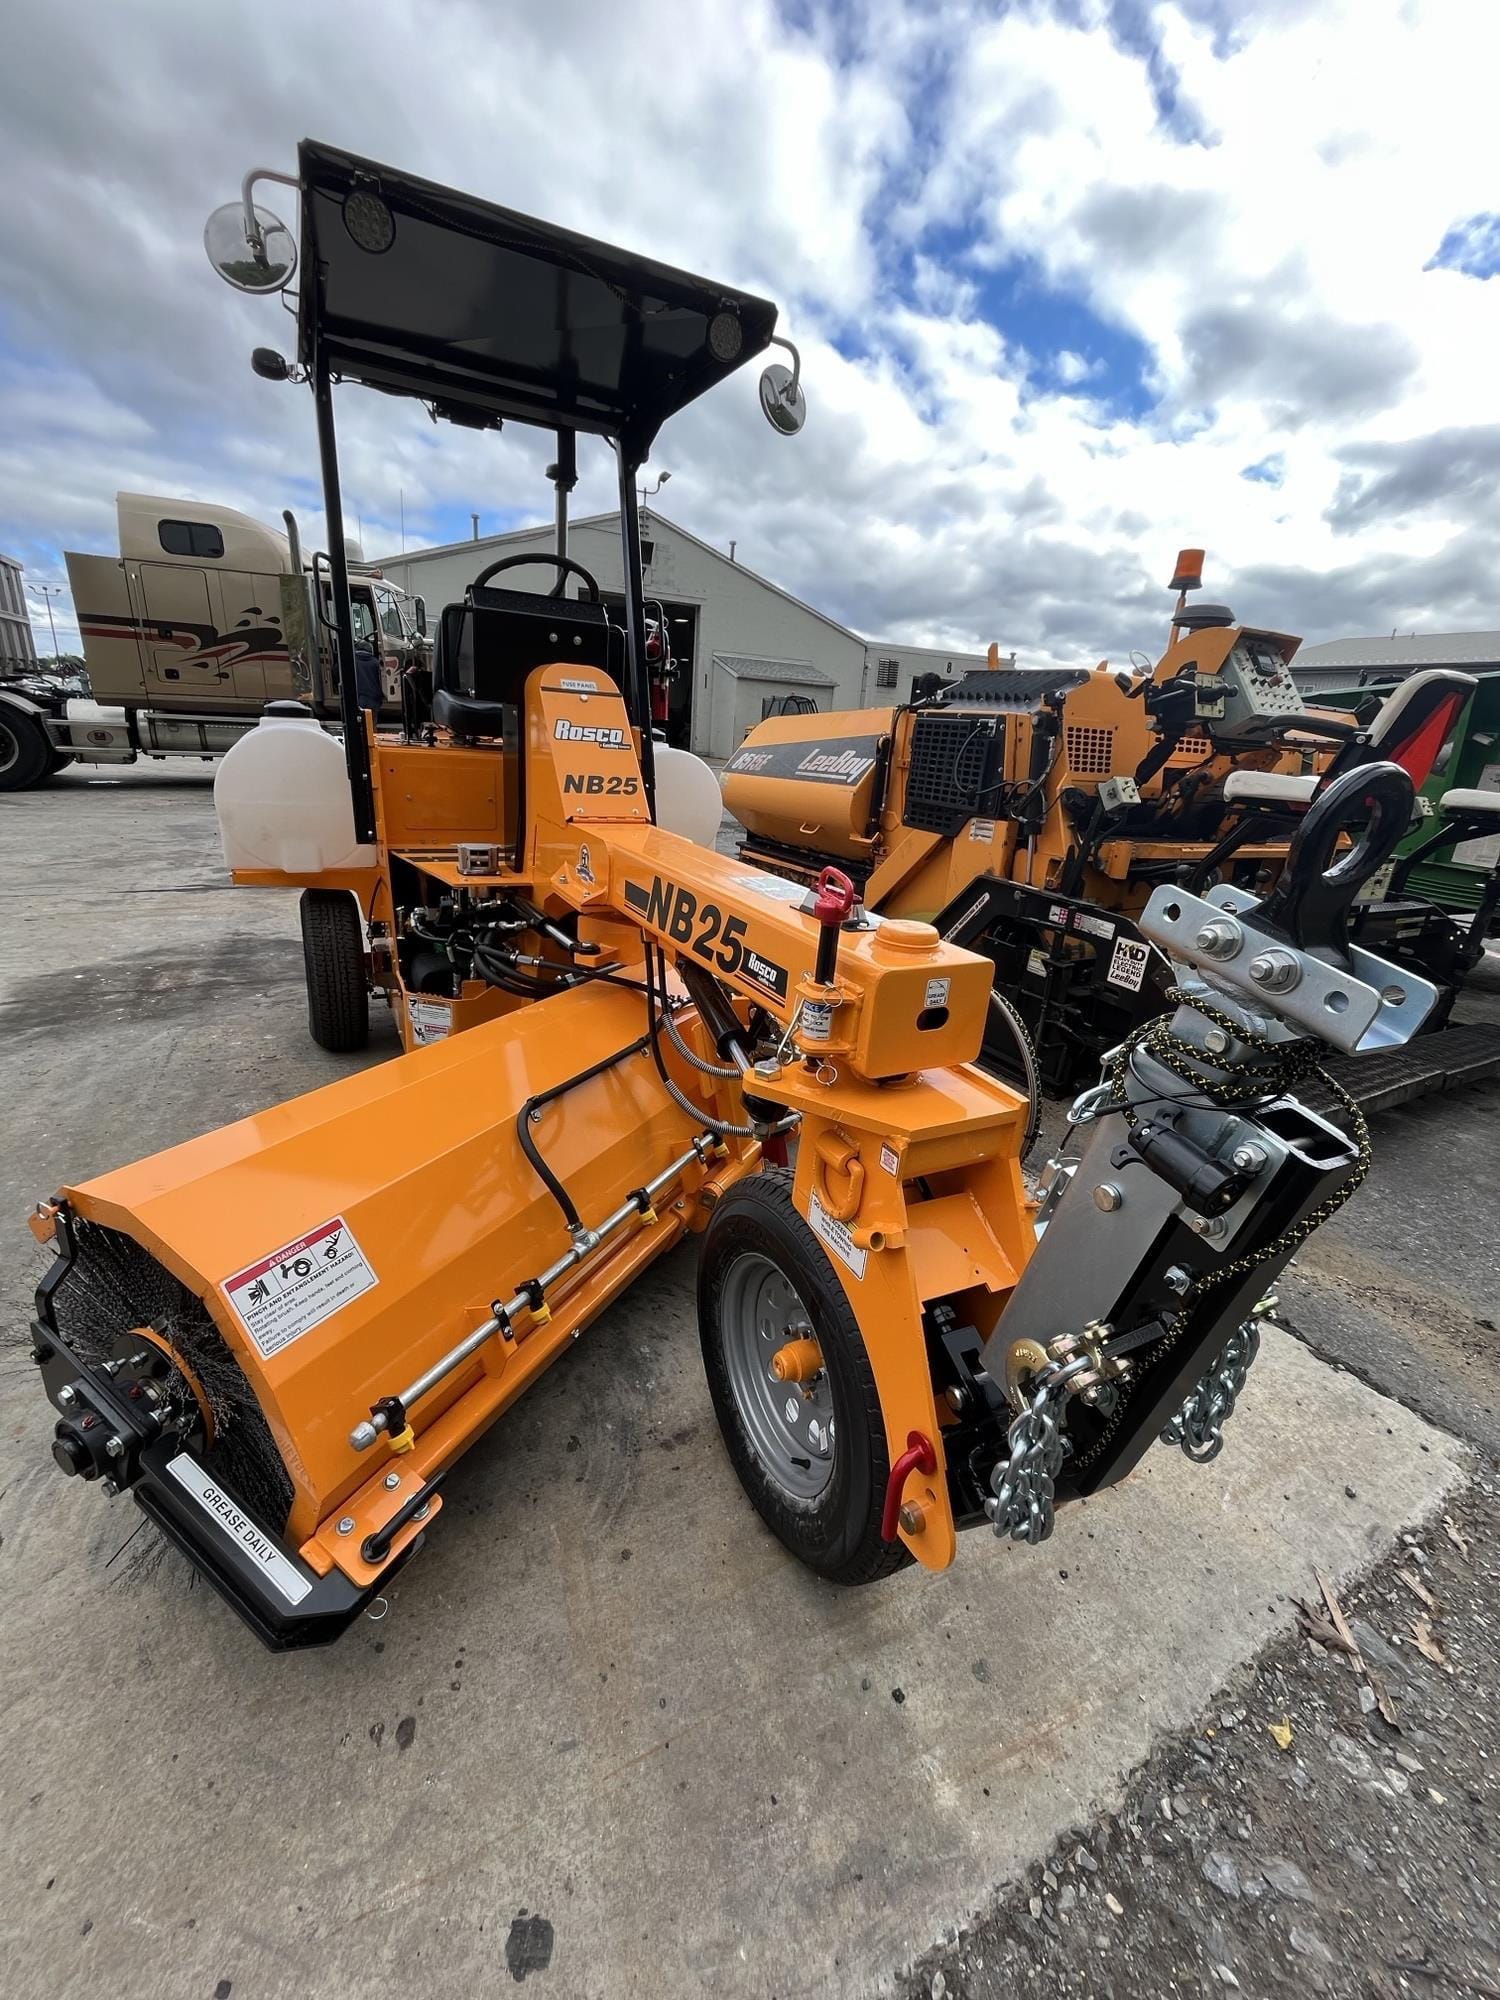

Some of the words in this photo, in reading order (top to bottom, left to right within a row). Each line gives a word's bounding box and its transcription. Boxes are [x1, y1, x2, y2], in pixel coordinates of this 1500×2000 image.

[946, 661, 953, 674] 8
[797, 748, 875, 783] LeeBoy
[564, 774, 638, 795] NB25
[646, 875, 749, 974] NB25
[1113, 958, 1143, 972] ELECTRIC
[1115, 955, 1130, 963] HEAVY
[1110, 970, 1140, 989] LeeBoy
[1112, 964, 1141, 978] LEGEND
[821, 1223, 831, 1236] THIS
[835, 1230, 852, 1251] TOWING
[274, 1241, 306, 1263] DANGER
[245, 1304, 268, 1321] PINCH
[267, 1295, 282, 1307] AND
[282, 1266, 330, 1298] ENTANGLEMENT
[253, 1316, 278, 1334] Rotating
[294, 1296, 309, 1308] Keep
[324, 1278, 336, 1288] feet
[334, 1273, 344, 1281] and
[342, 1261, 363, 1276] clothing
[250, 1316, 264, 1328] Stay
[263, 1308, 277, 1319] clear
[260, 1329, 282, 1346] Failure
[286, 1313, 307, 1329] comply
[305, 1307, 316, 1316] will
[315, 1297, 331, 1310] result
[334, 1285, 350, 1296] death
[264, 1336, 286, 1352] serious
[202, 1488, 247, 1533] GREASE
[243, 1530, 276, 1564] DAILY
